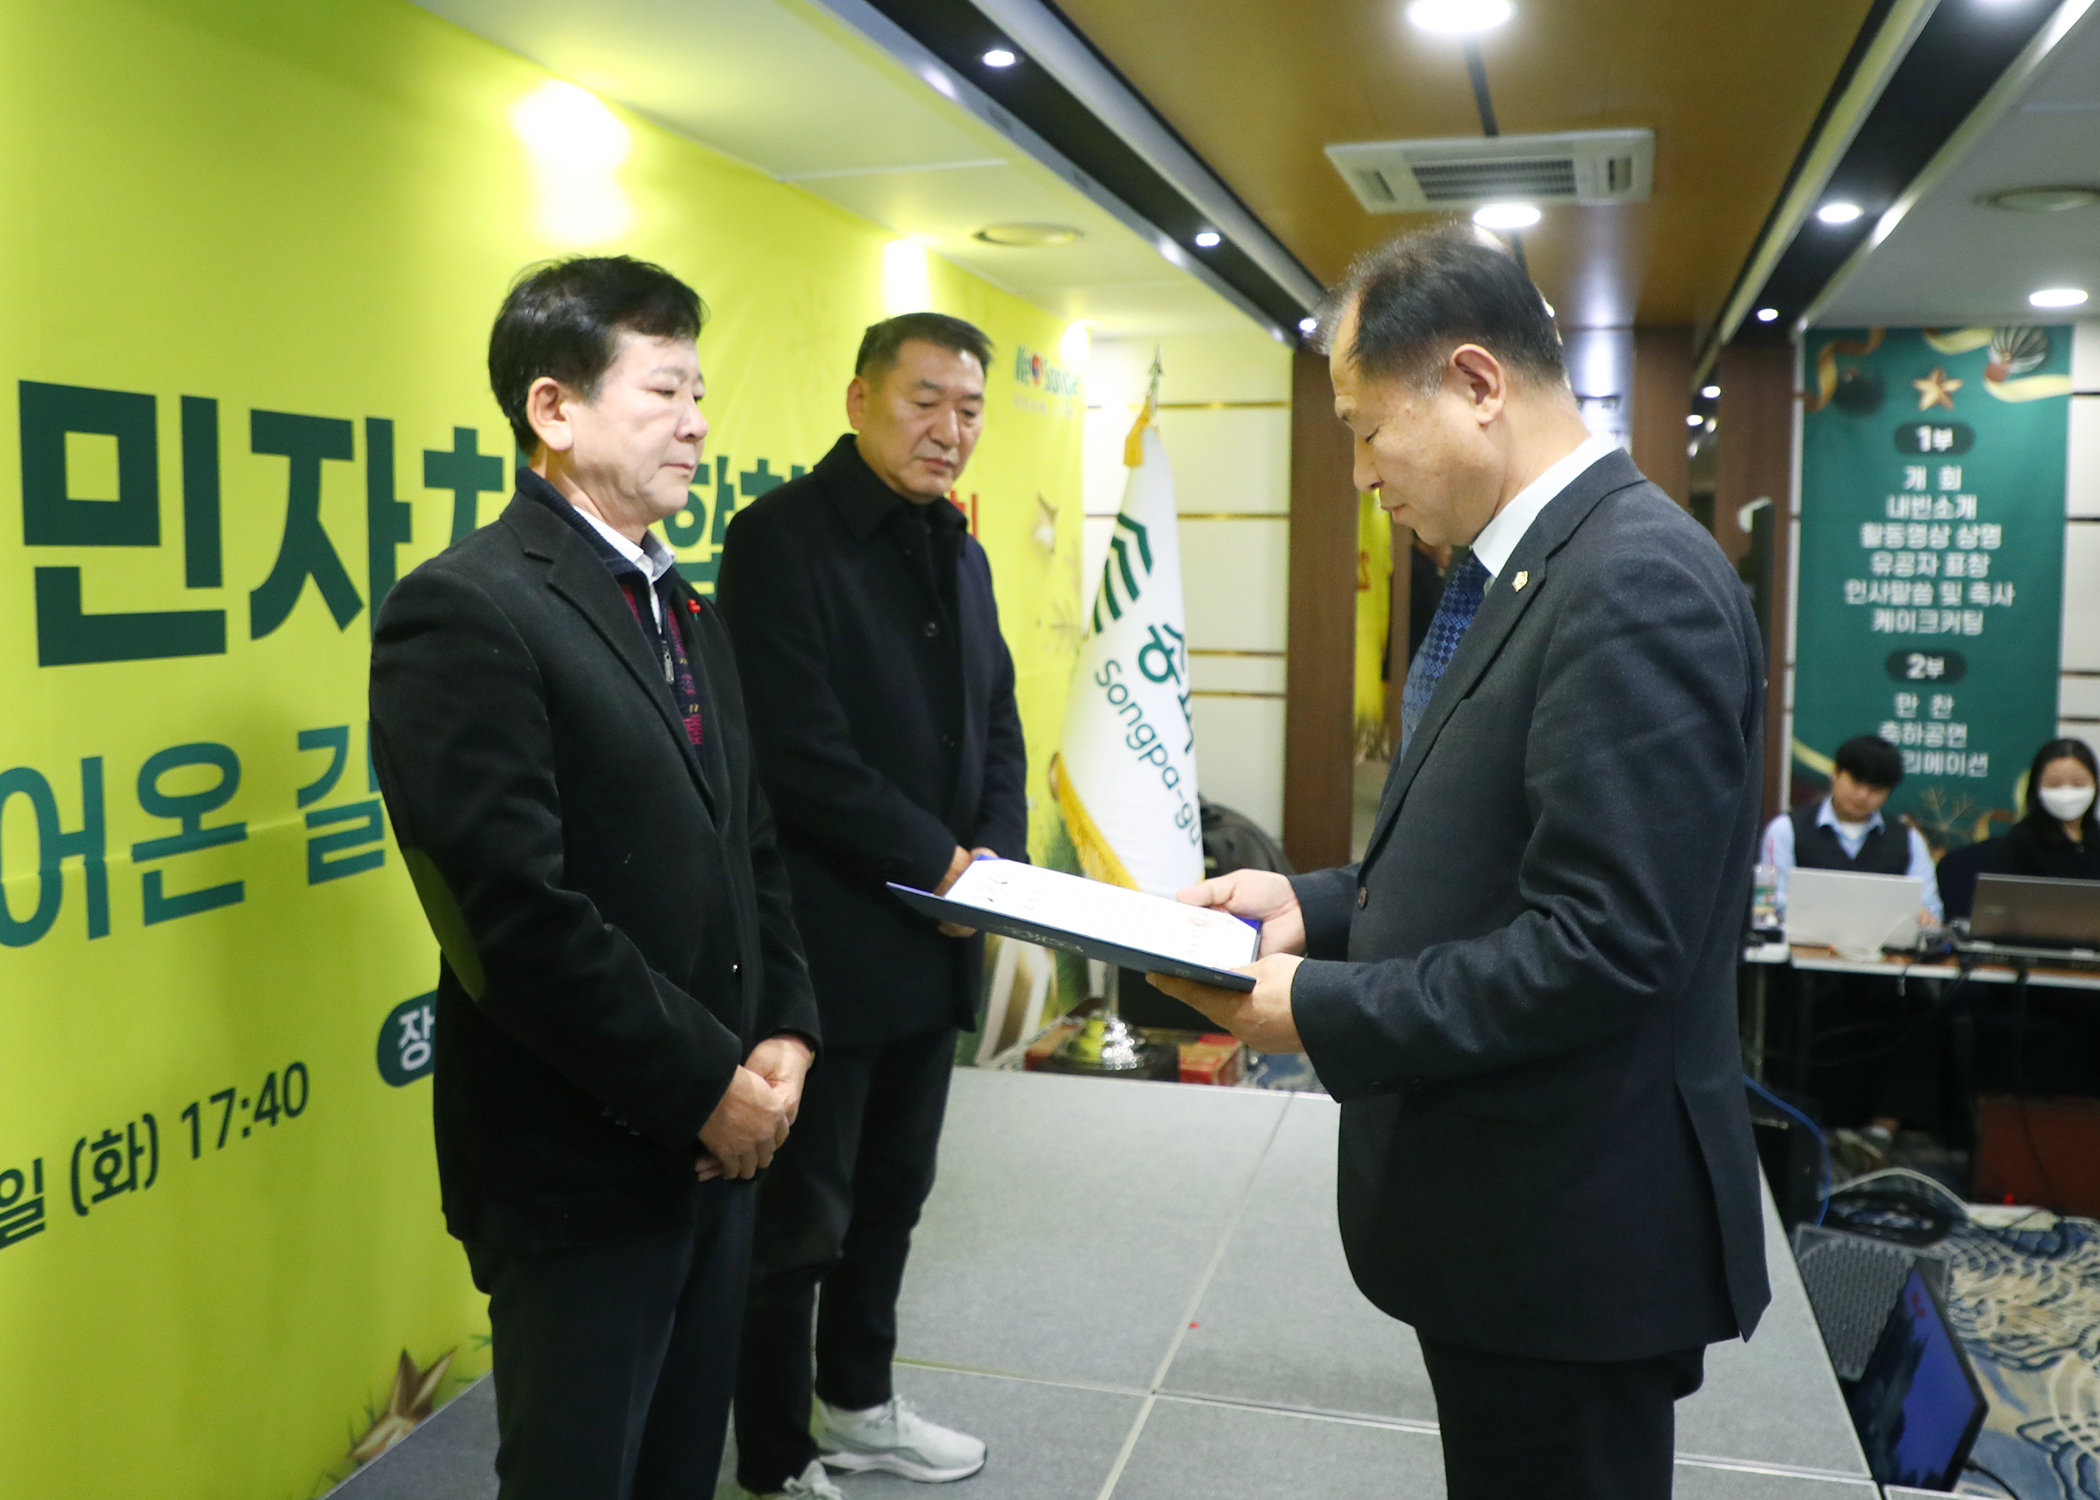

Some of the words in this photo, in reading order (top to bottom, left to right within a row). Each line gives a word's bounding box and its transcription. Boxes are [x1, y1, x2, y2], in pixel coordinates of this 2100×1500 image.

[1917, 425, 1954, 452] 1부
[1904, 465, 1927, 491] 개
[1939, 465, 1962, 491] 회
[1886, 494, 1978, 520] 내빈소개
[1861, 522, 1951, 549] 활동영상
[1956, 522, 2002, 549] 상영
[1871, 551, 1939, 578] 유공자
[1944, 551, 1991, 578] 표창
[1845, 578, 1934, 606] 인사말씀
[1939, 580, 1962, 606] 및
[1968, 580, 2016, 607] 축사
[1872, 607, 1984, 636] 케이크커팅
[1906, 652, 1945, 679] 2부
[1895, 692, 1919, 718] 만
[1931, 693, 1954, 719] 찬
[1879, 721, 1967, 748] 축하공연
[1096, 659, 1201, 847] Songpa-gu
[297, 724, 386, 887] 길
[69, 1112, 159, 1217] (화)
[180, 1061, 310, 1160] 17:40
